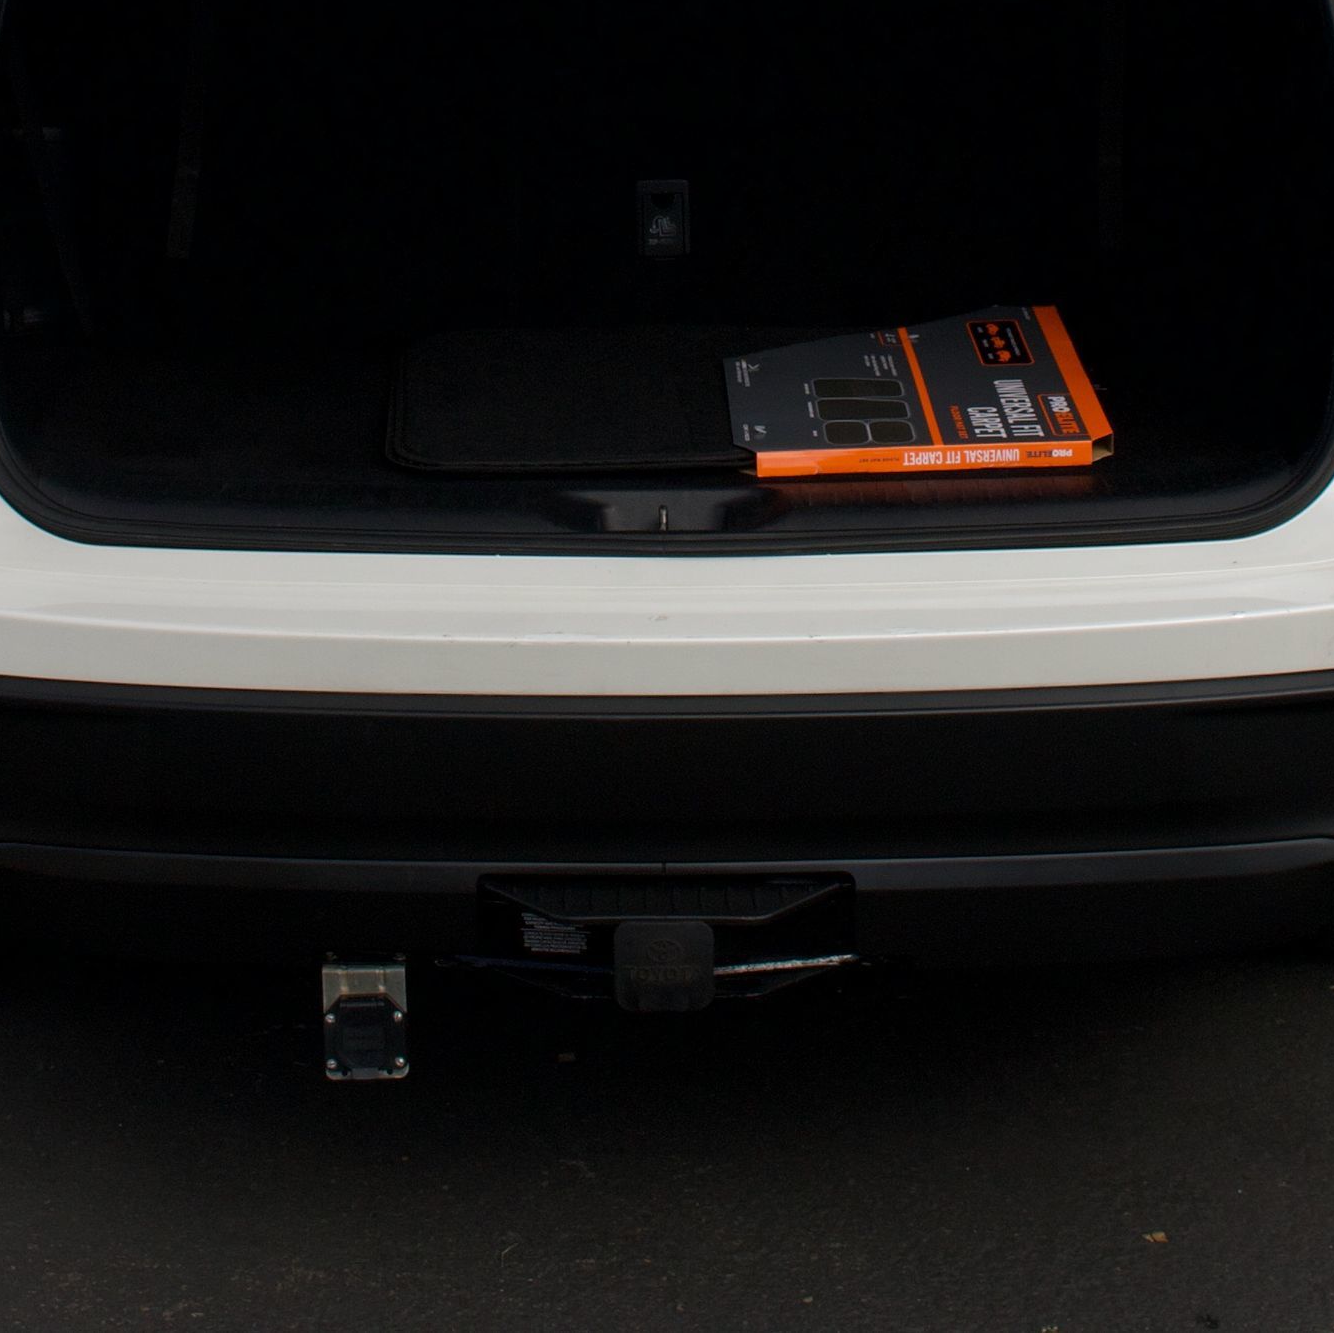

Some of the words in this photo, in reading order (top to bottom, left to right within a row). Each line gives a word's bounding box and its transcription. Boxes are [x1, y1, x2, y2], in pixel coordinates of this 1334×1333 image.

[993, 379, 1038, 423] UNIVERSAL
[967, 406, 1008, 439] CARPET
[1010, 424, 1045, 438] FIT
[903, 451, 944, 466] CARPET
[945, 450, 962, 464] FIT
[963, 448, 1020, 463] UNIVERSAL
[623, 964, 702, 983] TOYOTA
